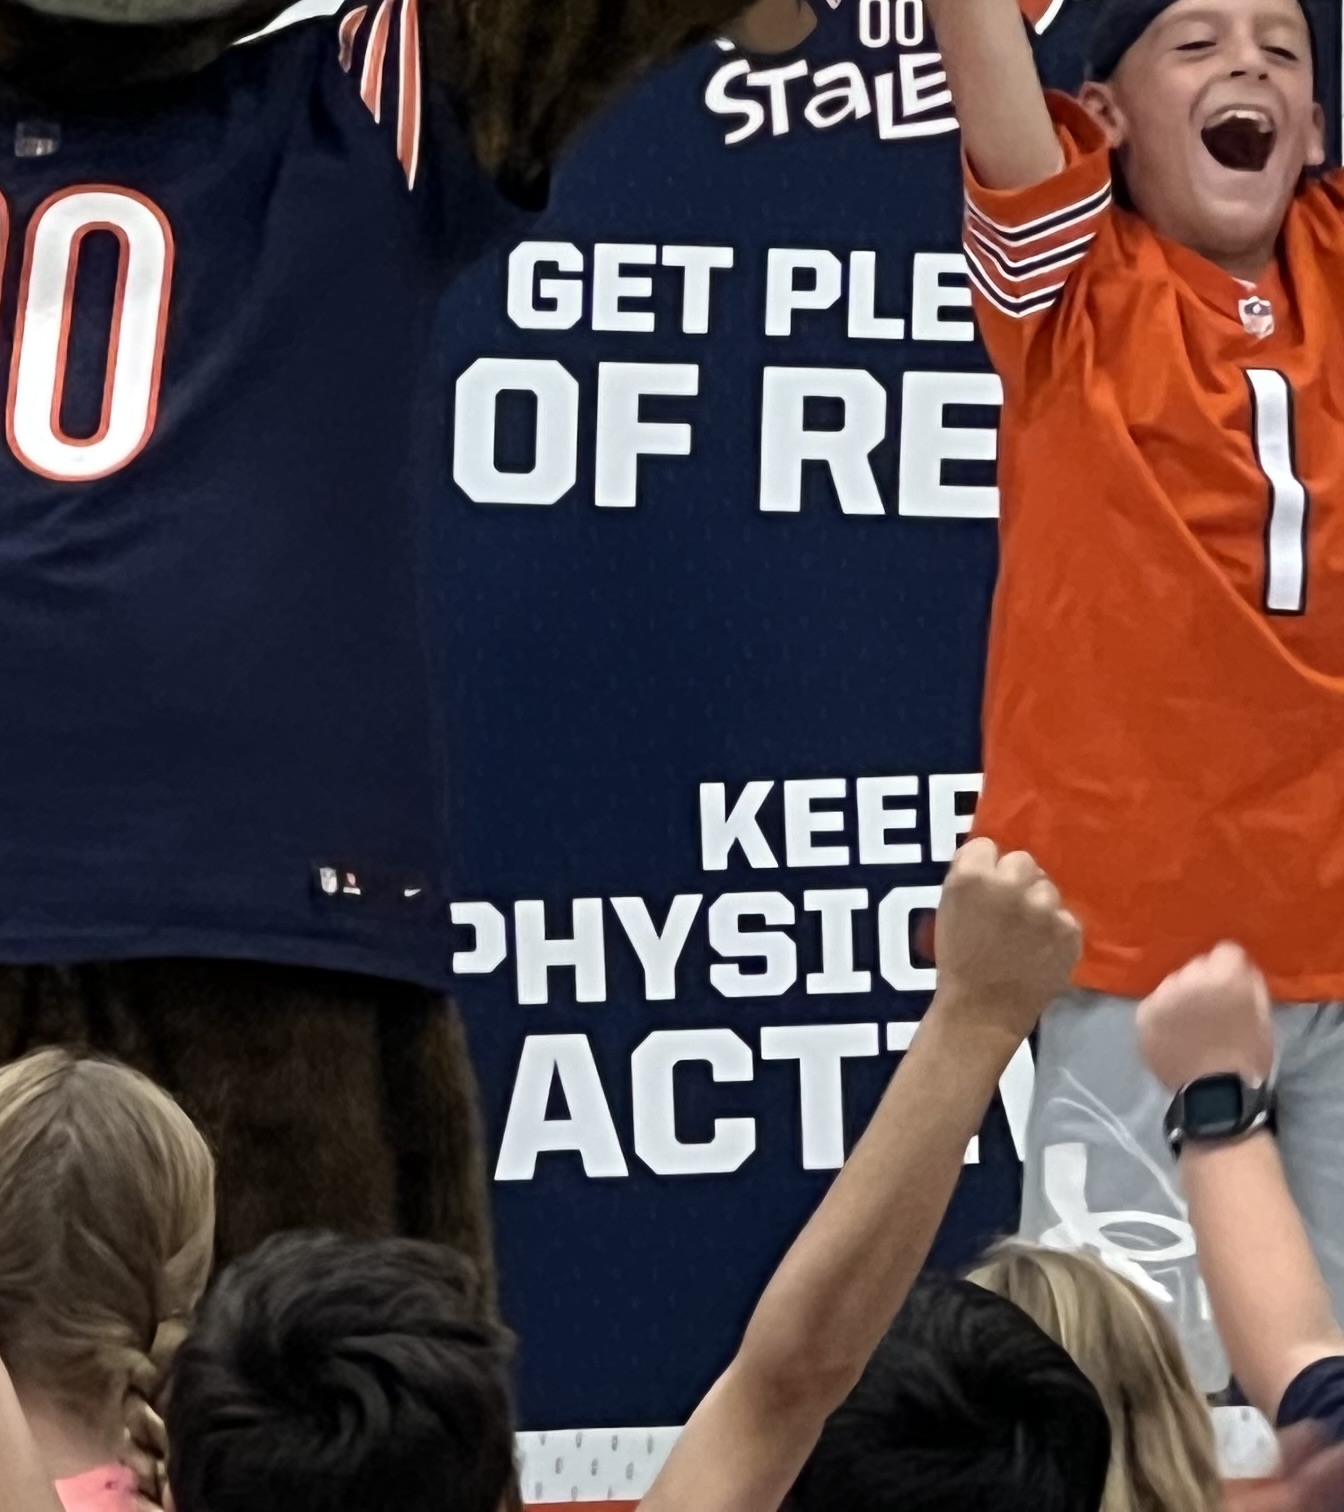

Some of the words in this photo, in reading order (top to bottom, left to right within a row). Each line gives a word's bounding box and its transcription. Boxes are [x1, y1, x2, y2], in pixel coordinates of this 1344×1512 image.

[507, 241, 734, 334] GET
[453, 357, 699, 508] OF
[1243, 368, 1308, 615] 1
